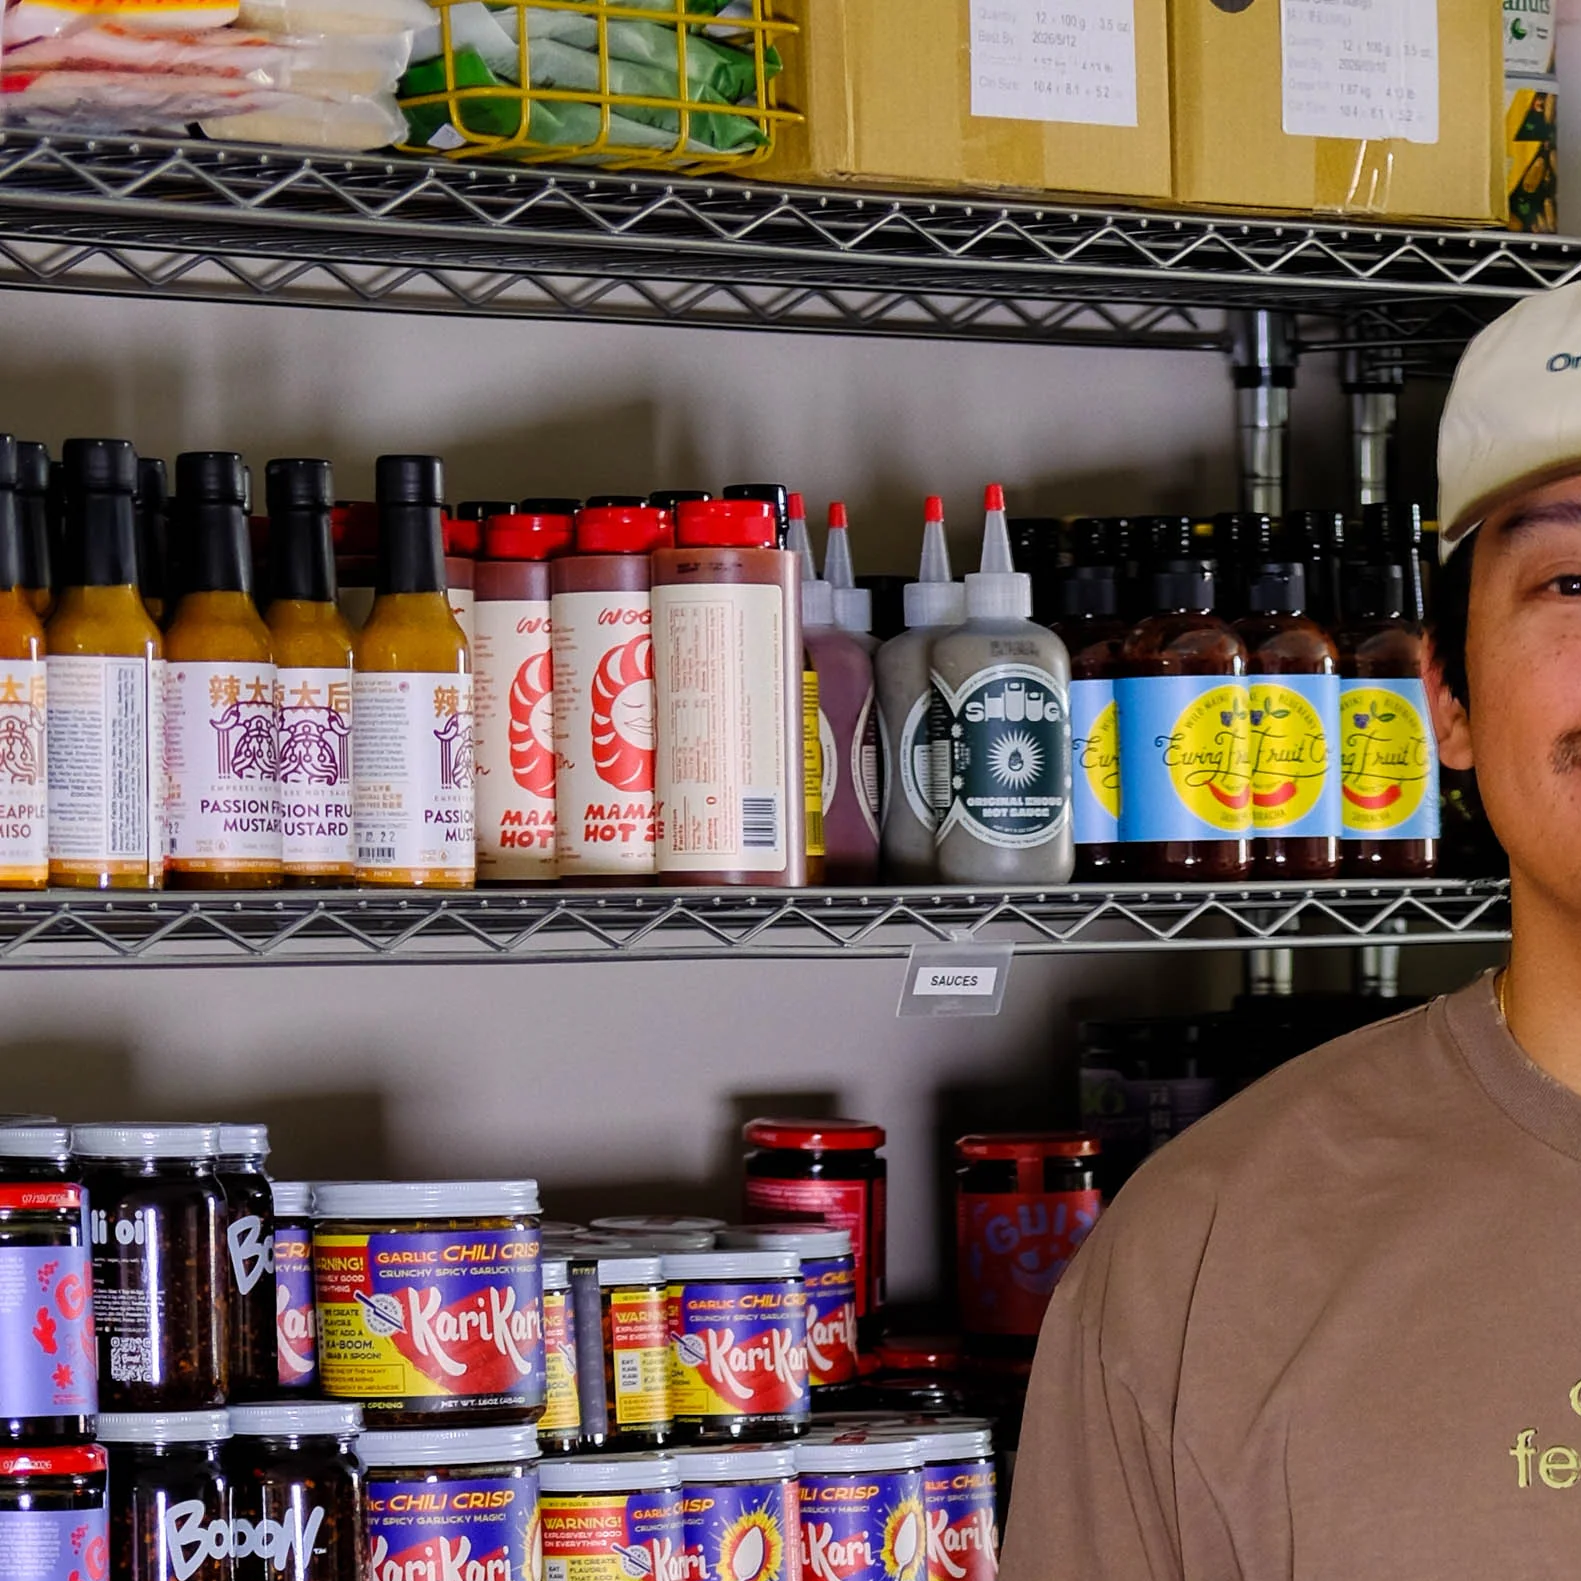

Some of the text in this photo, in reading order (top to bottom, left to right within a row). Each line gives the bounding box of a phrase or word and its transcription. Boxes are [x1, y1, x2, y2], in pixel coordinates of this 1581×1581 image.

[201, 800, 270, 814] PASSION
[982, 807, 1050, 818] HOT SAUCE
[500, 829, 553, 848] HOT
[584, 824, 636, 842] HOT
[930, 975, 978, 986] SAUCES
[377, 1241, 540, 1264] GARLIC CHILI CRISP
[379, 1268, 433, 1278] CRUNCHY
[435, 1267, 468, 1276] SPICY
[688, 1295, 781, 1309] GARLIC CHILI
[408, 1286, 542, 1377] KariKari
[389, 1490, 516, 1511] CHILI CRISP
[821, 1486, 881, 1501] CRISP
[838, 1505, 870, 1513] MAGIC!
[382, 1513, 506, 1526] SPICY GARLICKY MAGIC!
[544, 1516, 622, 1530] WARNING!
[595, 1530, 623, 1538] GOOD
[555, 1540, 607, 1548] EVERYTHING
